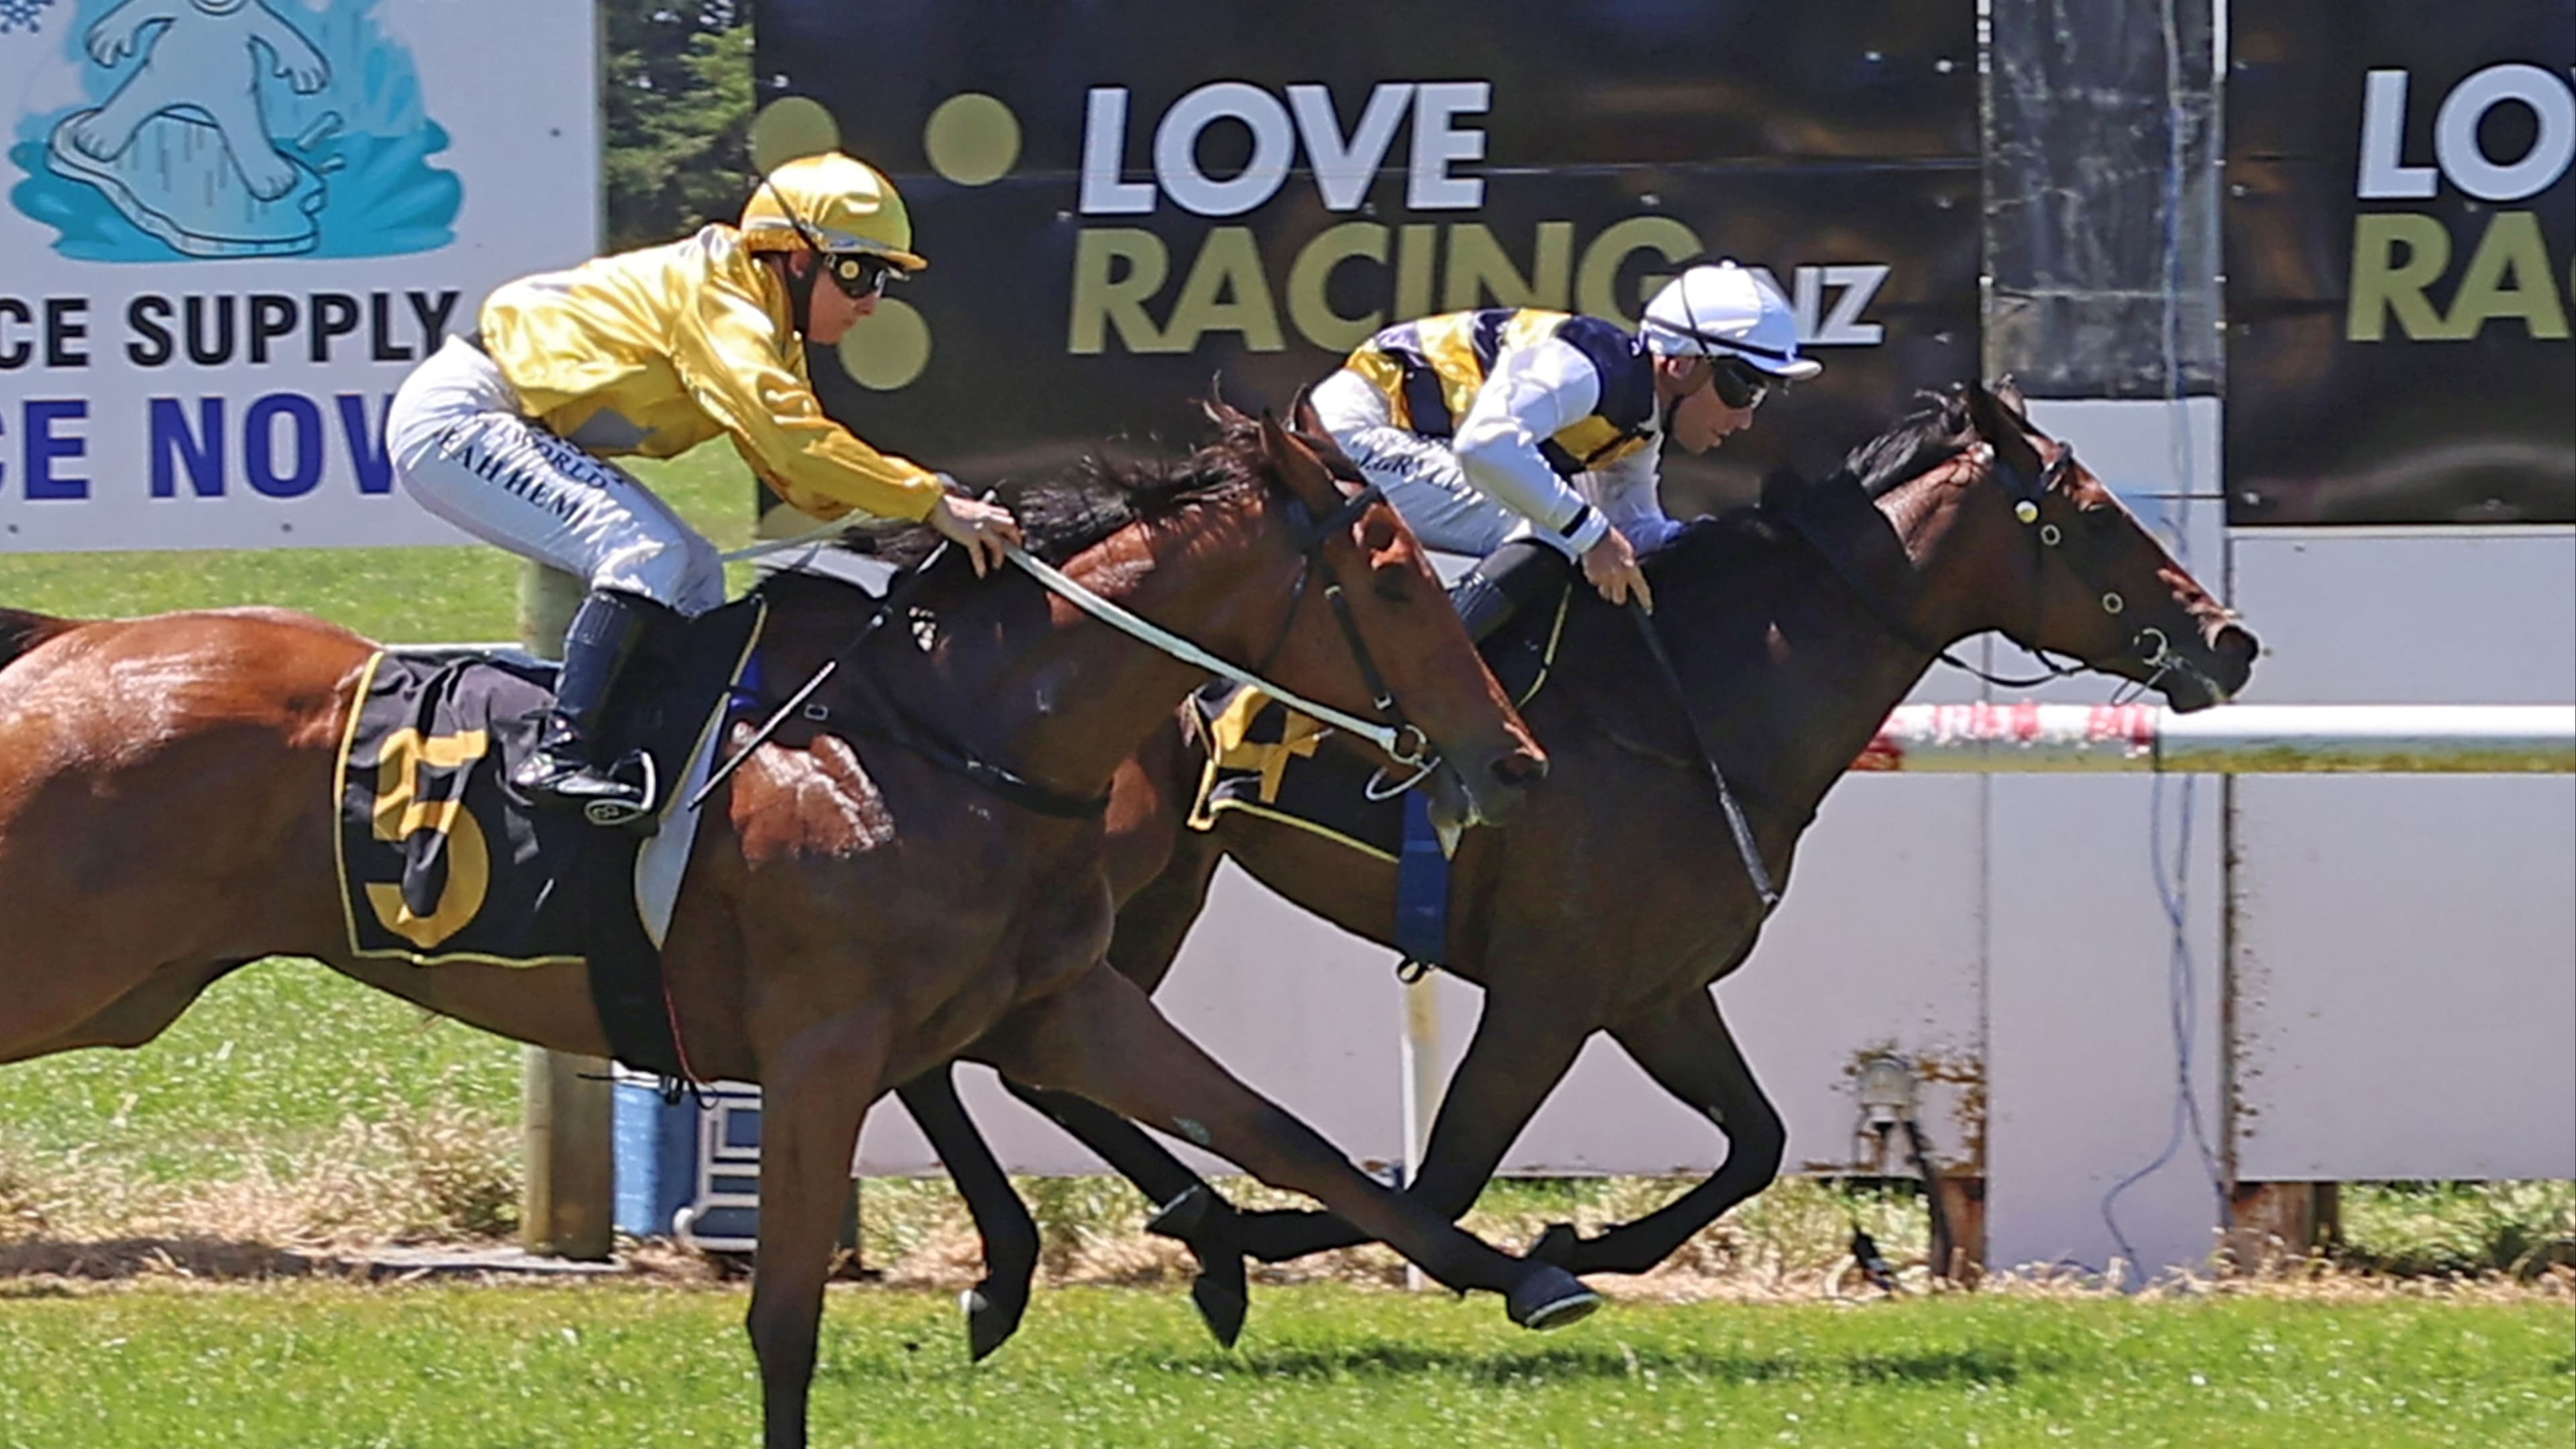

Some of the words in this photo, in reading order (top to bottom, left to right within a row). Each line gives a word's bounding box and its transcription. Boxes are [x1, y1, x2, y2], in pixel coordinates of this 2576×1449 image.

[1080, 82, 1490, 217] LOVE
[2357, 64, 2576, 201] LO
[0, 298, 89, 370] CE
[125, 291, 461, 368] SUPPLY
[1069, 217, 1705, 353] RACING
[2347, 211, 2576, 340] RA
[0, 398, 90, 500] E
[1212, 685, 1323, 804] 4
[365, 727, 490, 949] 5
